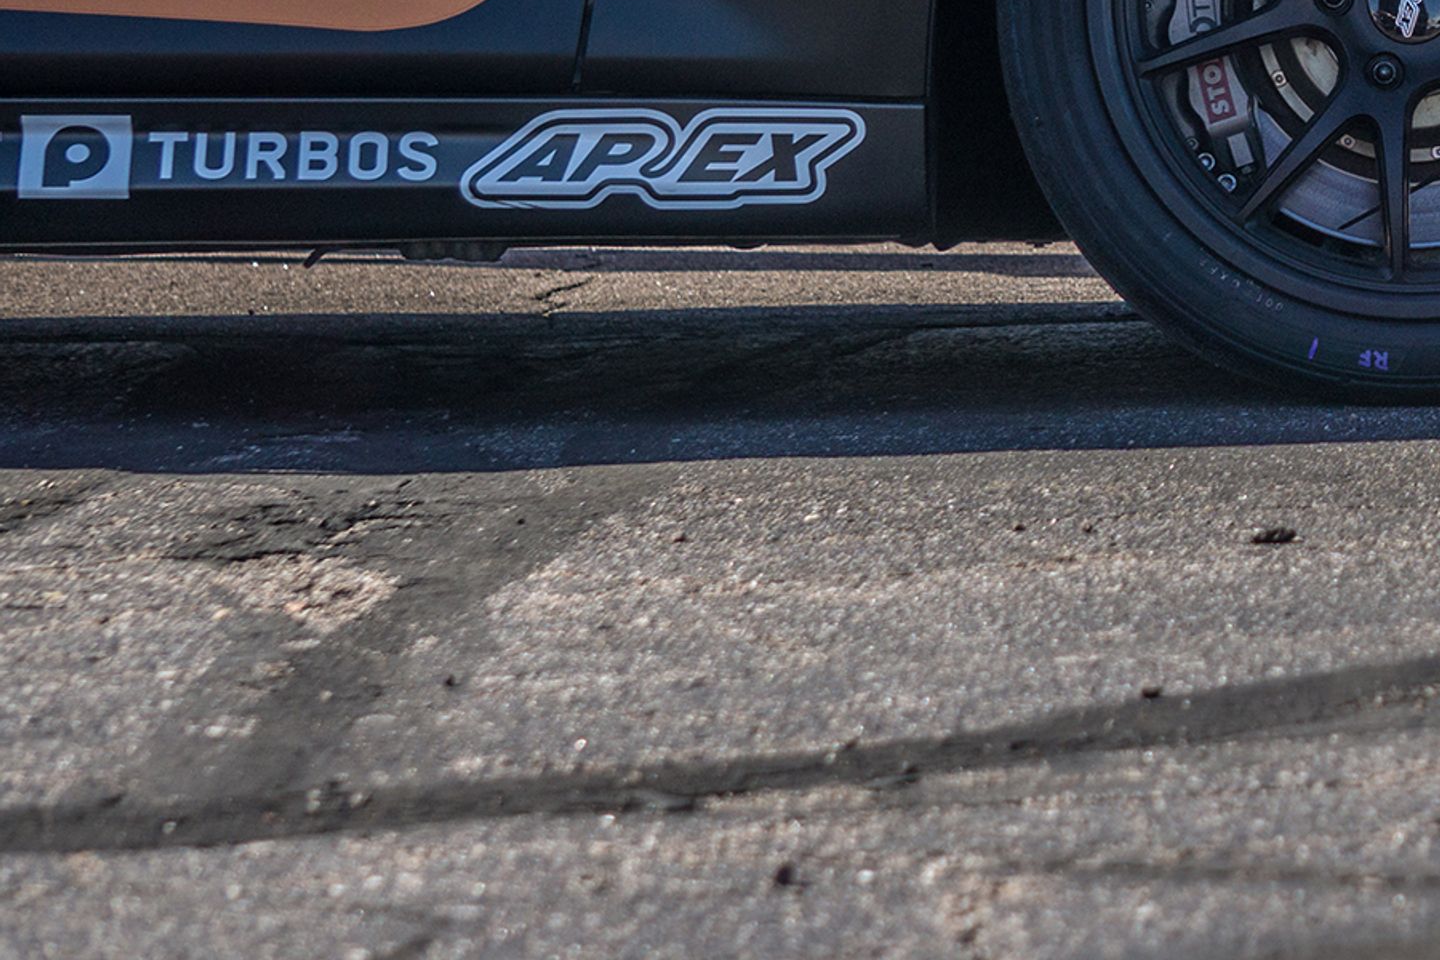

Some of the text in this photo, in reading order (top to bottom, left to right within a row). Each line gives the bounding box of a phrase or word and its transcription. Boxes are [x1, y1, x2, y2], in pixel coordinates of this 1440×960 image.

[1202, 58, 1230, 117] STO
[149, 131, 439, 181] TURBOS
[480, 125, 848, 190] APEX
[1358, 349, 1389, 371] RF
